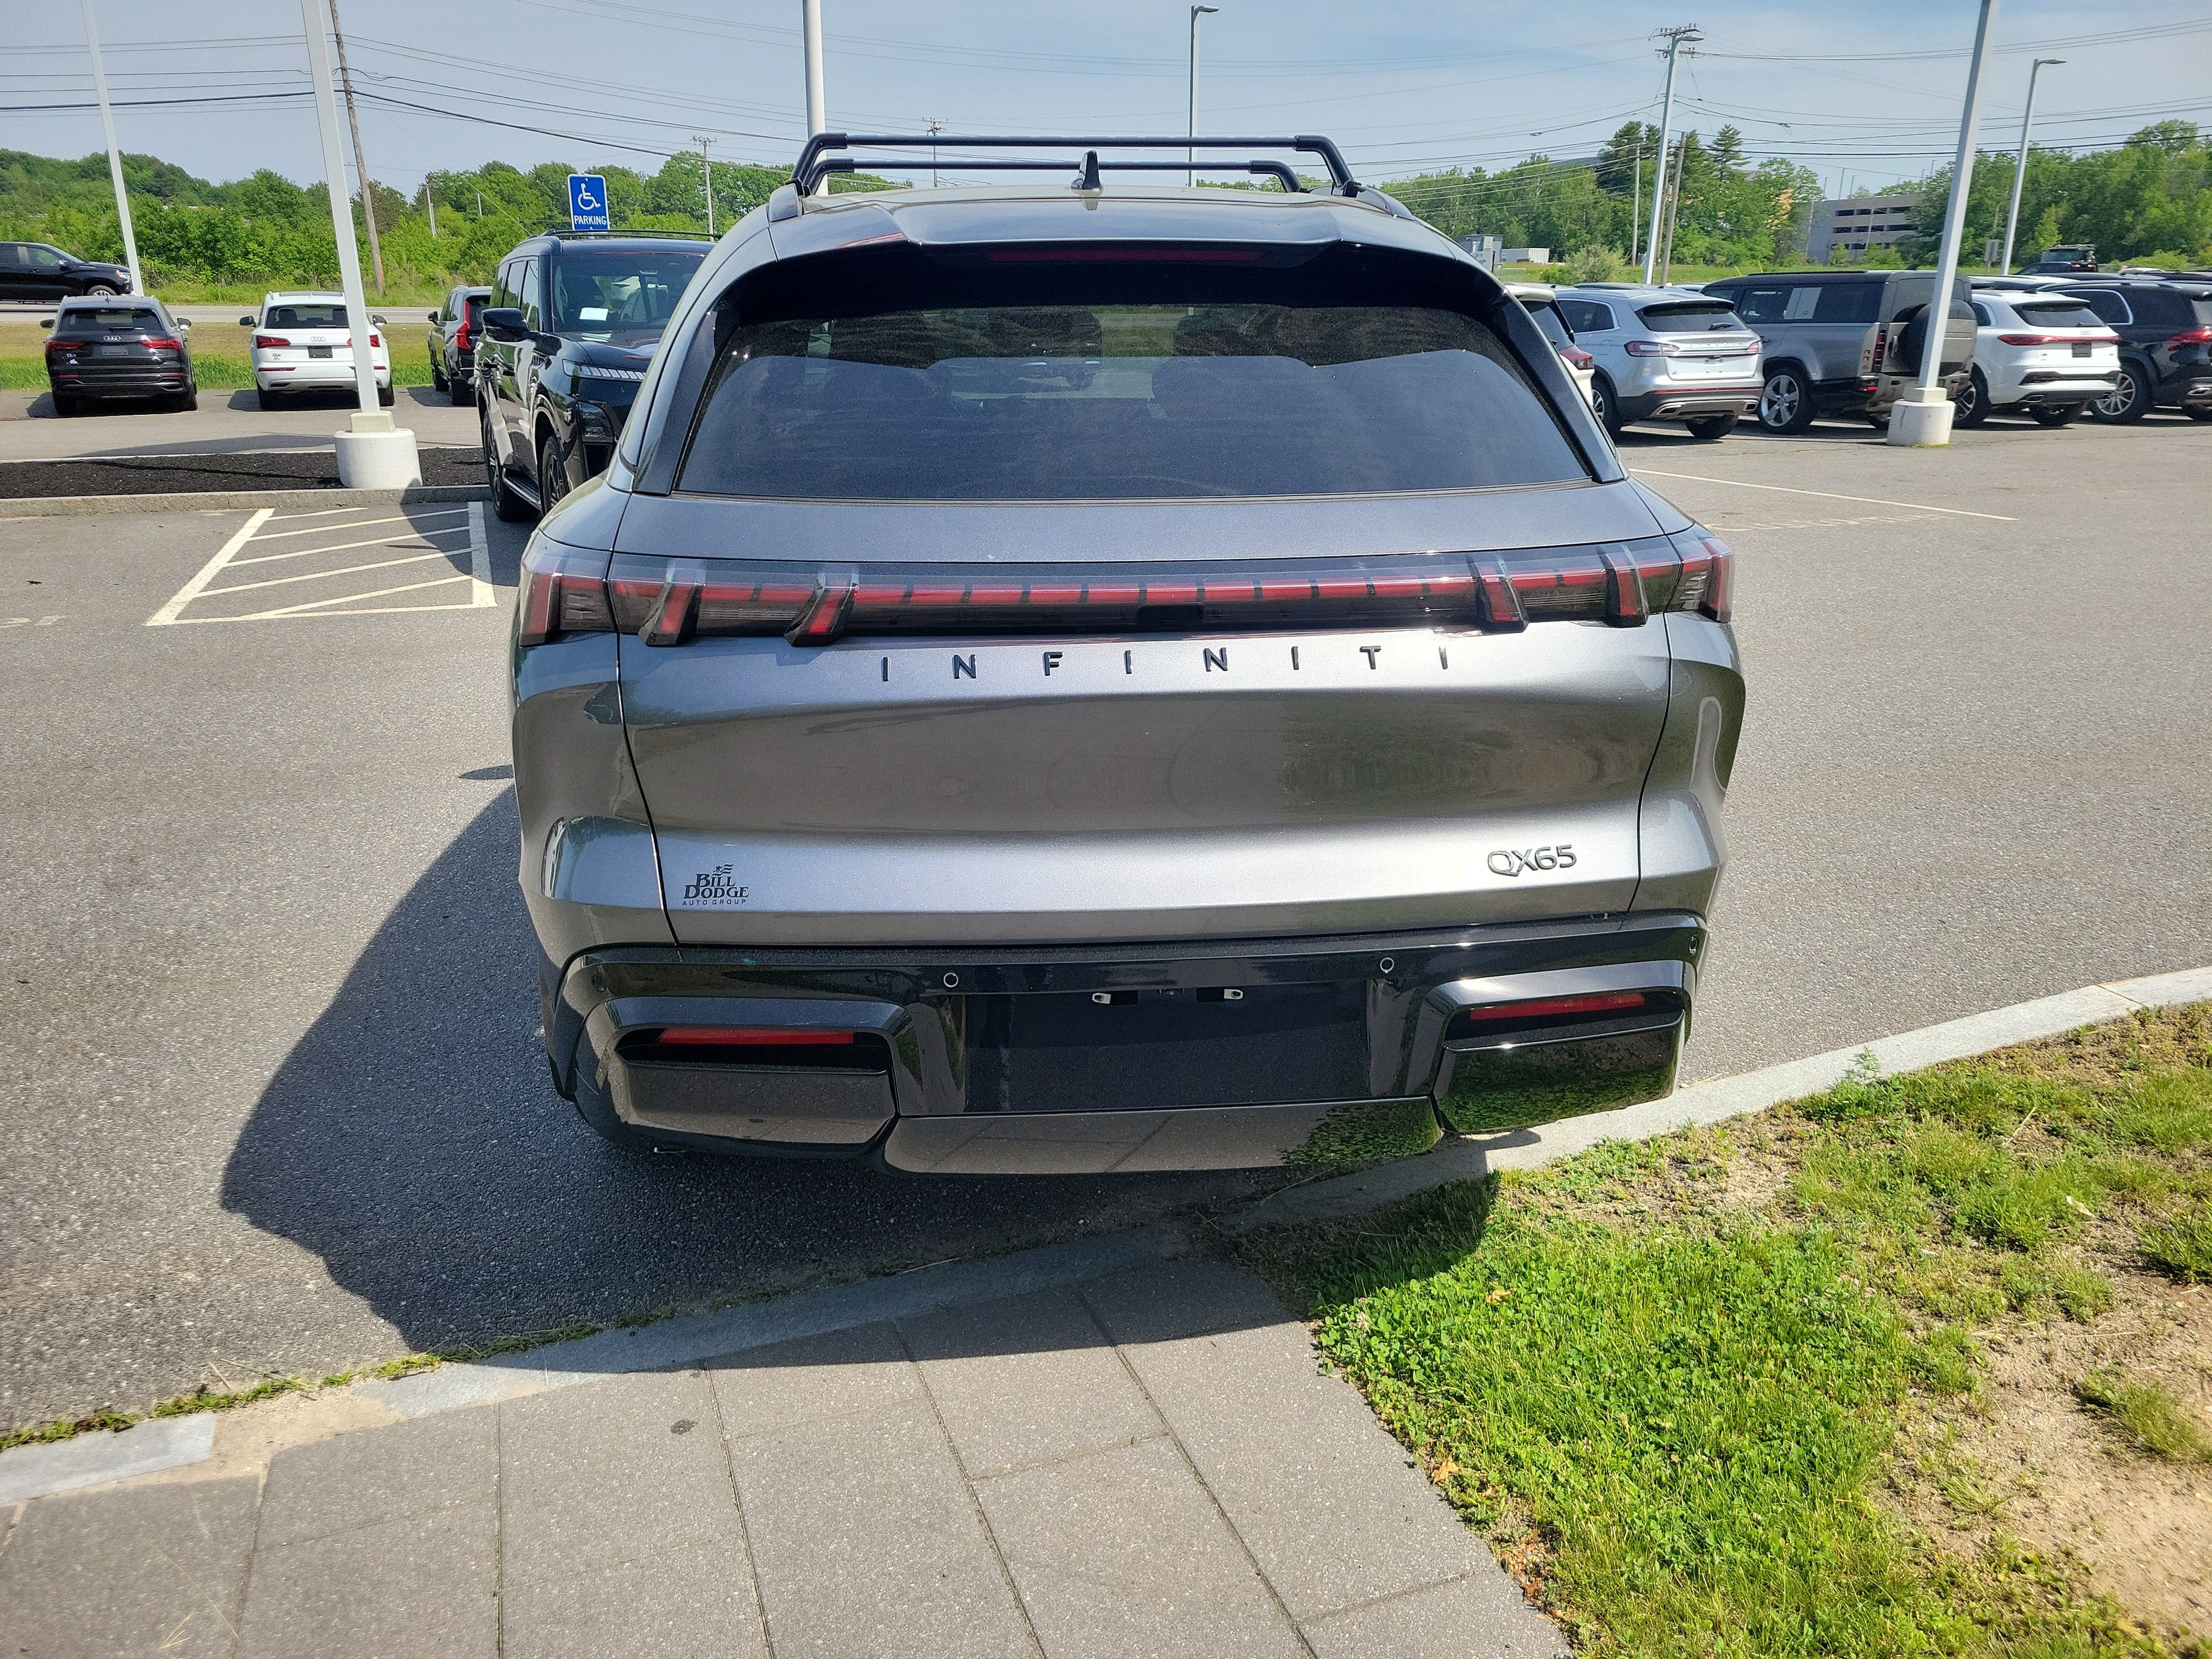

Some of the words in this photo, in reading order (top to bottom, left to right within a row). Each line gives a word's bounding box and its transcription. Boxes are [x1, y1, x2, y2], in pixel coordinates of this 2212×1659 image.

[574, 215, 607, 225] PARKING
[882, 645, 1448, 682] INFINITI
[1487, 844, 1577, 877] QX65
[696, 873, 736, 887] BILL
[683, 884, 749, 899] DODGE
